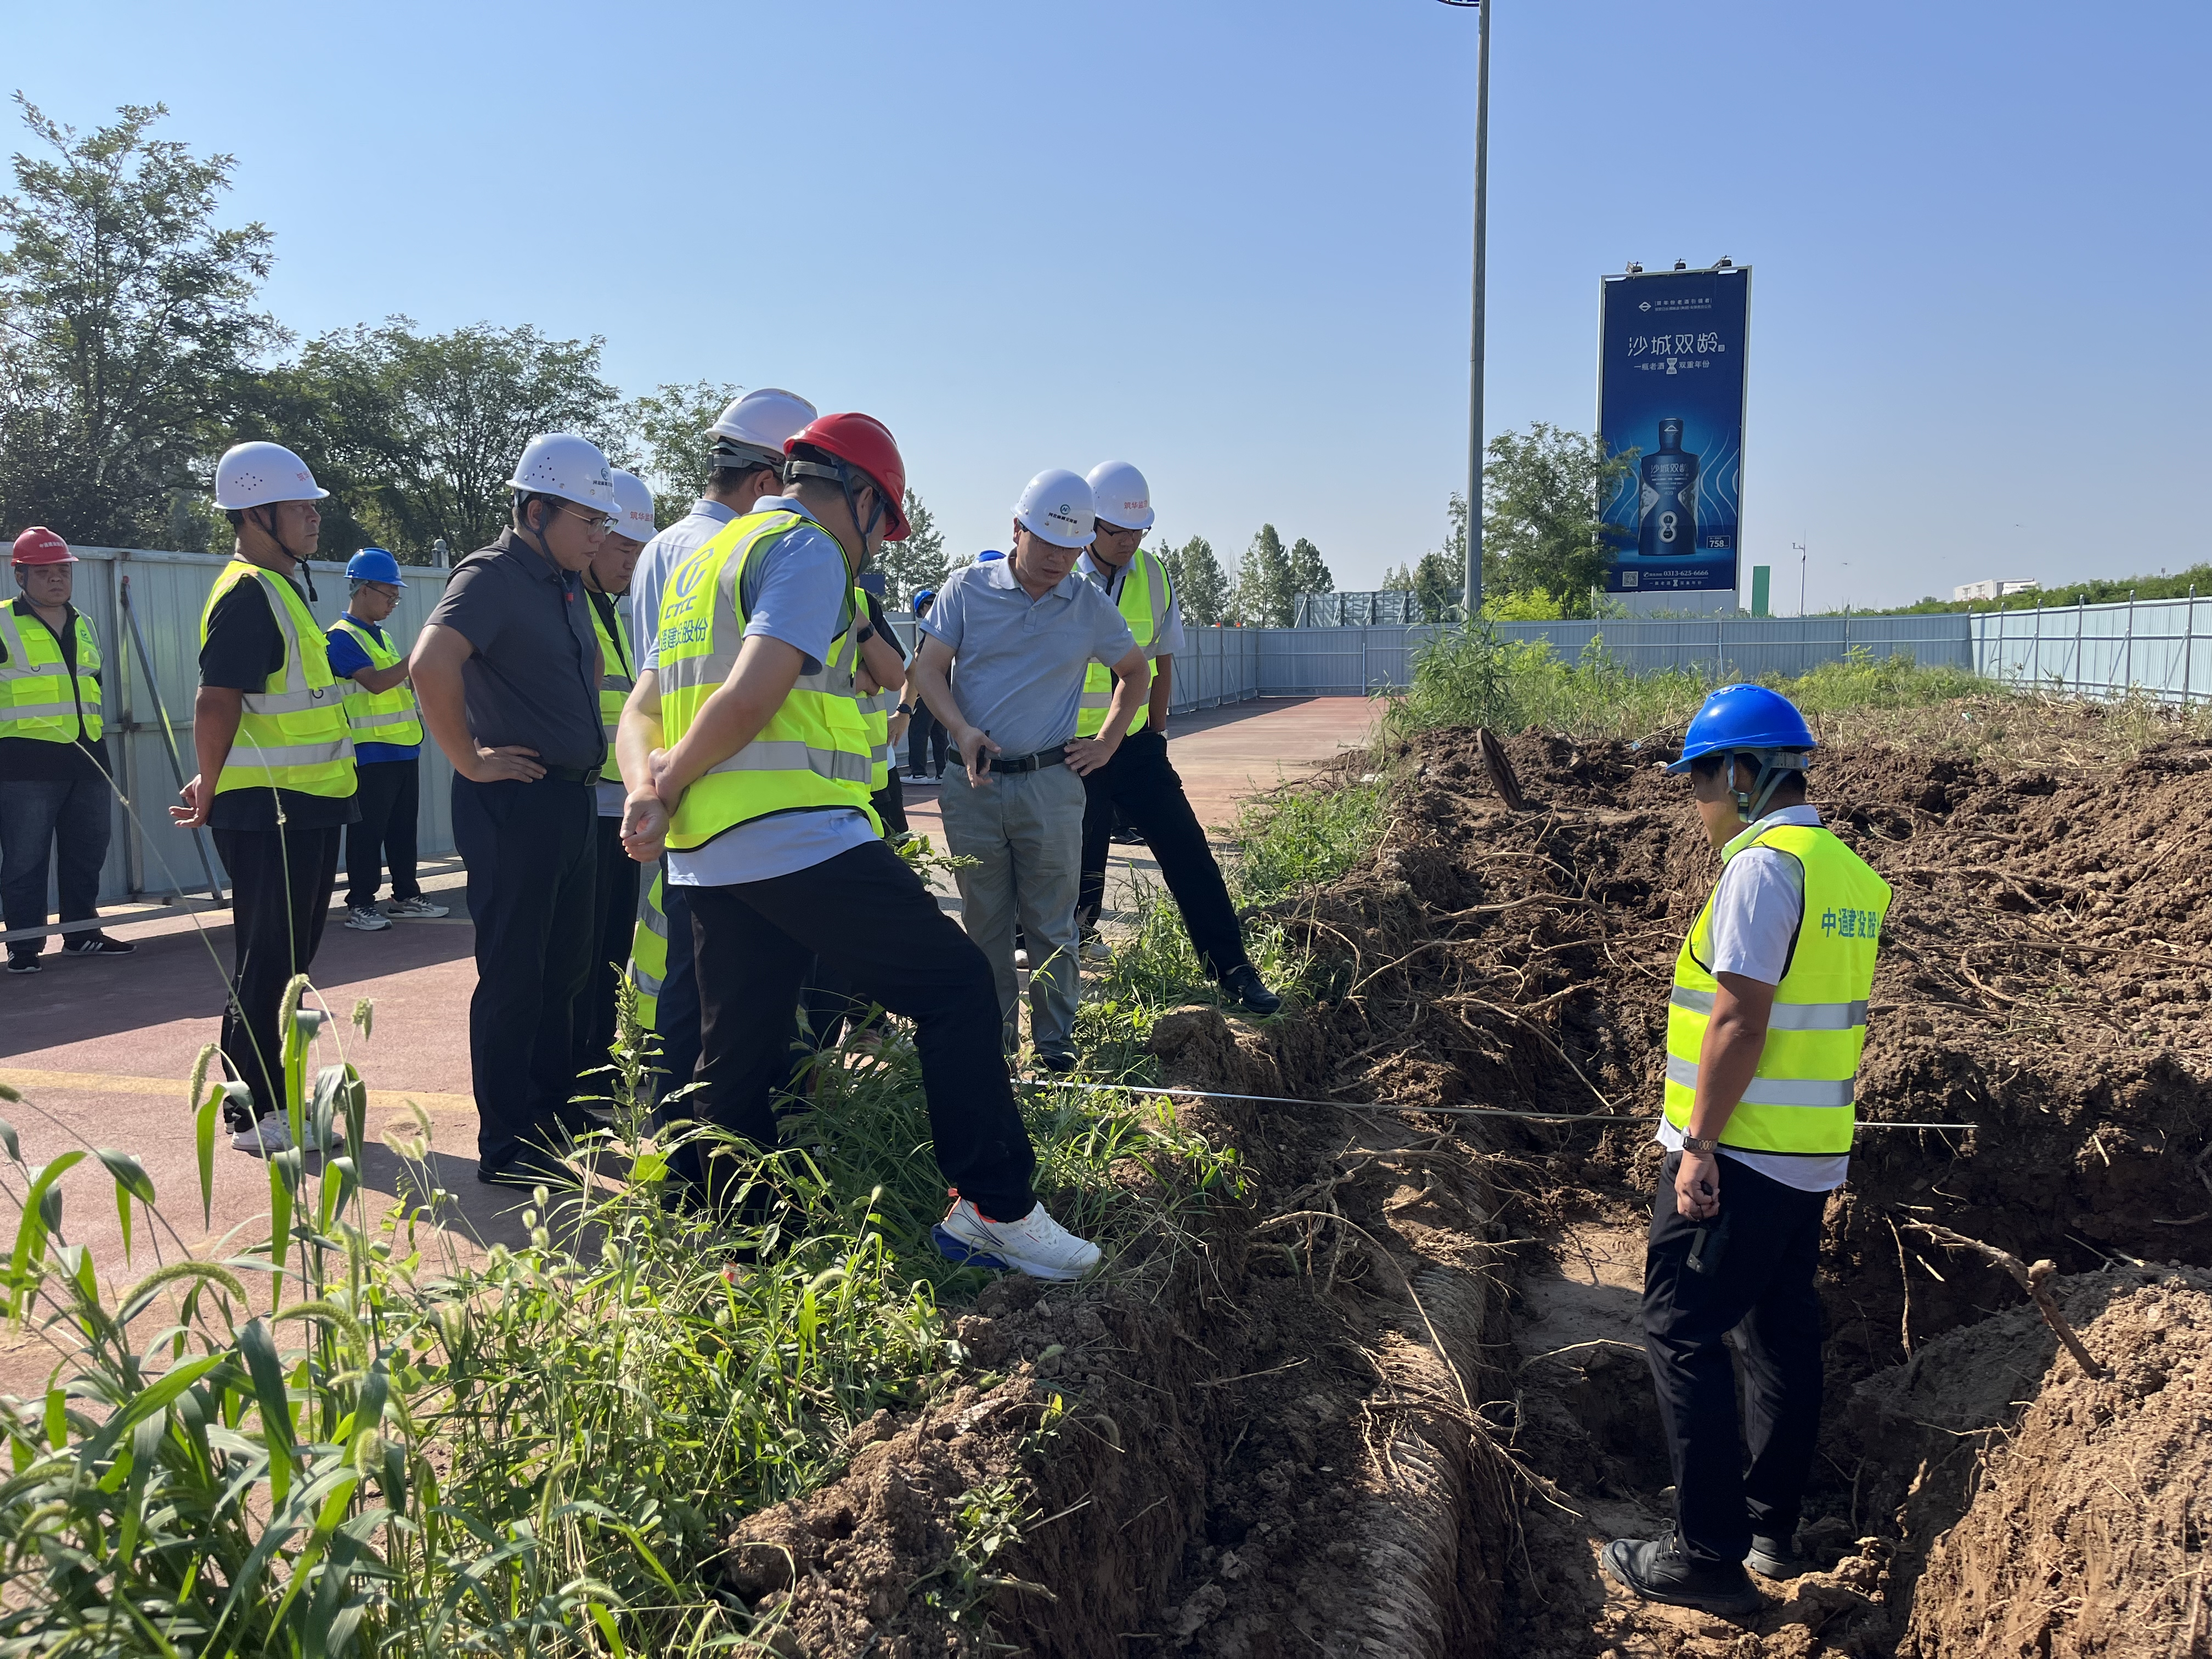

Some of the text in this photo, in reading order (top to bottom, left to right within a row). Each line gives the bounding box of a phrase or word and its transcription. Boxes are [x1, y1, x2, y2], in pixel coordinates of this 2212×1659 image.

[1628, 332, 1718, 357] 沙城双龄
[1679, 360, 1710, 369] 双重年份
[1821, 907, 1880, 939] 中通建设股
